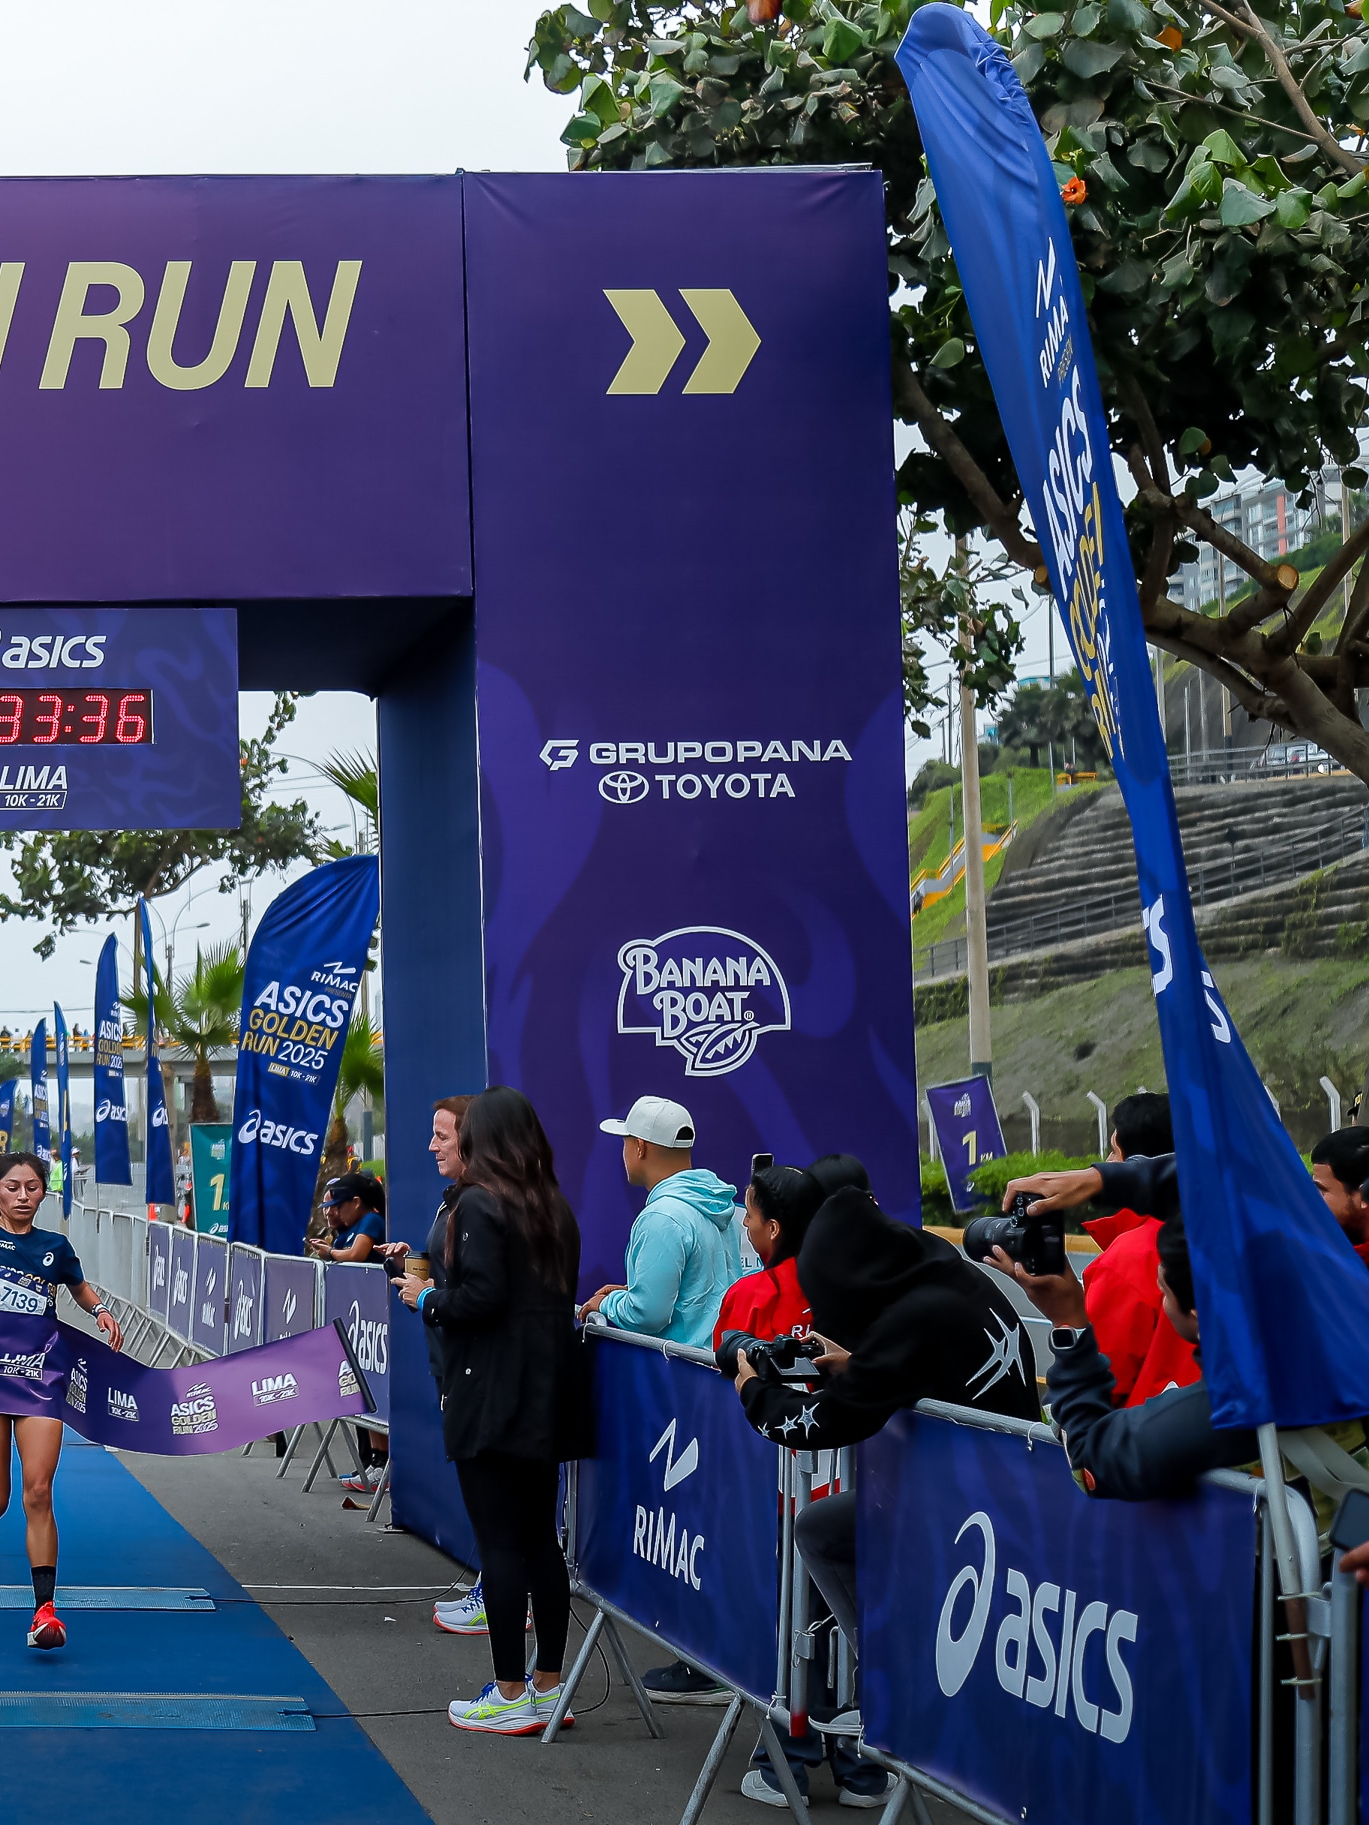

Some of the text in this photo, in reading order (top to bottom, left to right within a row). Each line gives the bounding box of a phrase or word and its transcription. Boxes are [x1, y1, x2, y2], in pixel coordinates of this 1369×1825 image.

[39, 260, 362, 391] RUN
[1039, 274, 1069, 388] RIMA
[2, 635, 106, 670] asics
[590, 739, 853, 763] GRUPOPANA
[657, 773, 795, 797] TOYOTA
[311, 971, 358, 993] RIMAC
[626, 947, 771, 995] BANANA
[254, 980, 349, 1028] ASICS
[249, 1008, 339, 1050] GOLDEN
[241, 1031, 328, 1070] RUN 2025
[260, 1120, 319, 1155] asics
[962, 1130, 977, 1166] 1
[210, 1173, 225, 1211] 1
[1, 1285, 38, 1313] 7139
[108, 1387, 138, 1410] LIMA
[251, 1373, 298, 1396] LIMA
[171, 1396, 215, 1417] ASICS
[633, 1504, 705, 1591] RIMAC
[994, 1567, 1139, 1744] asics
